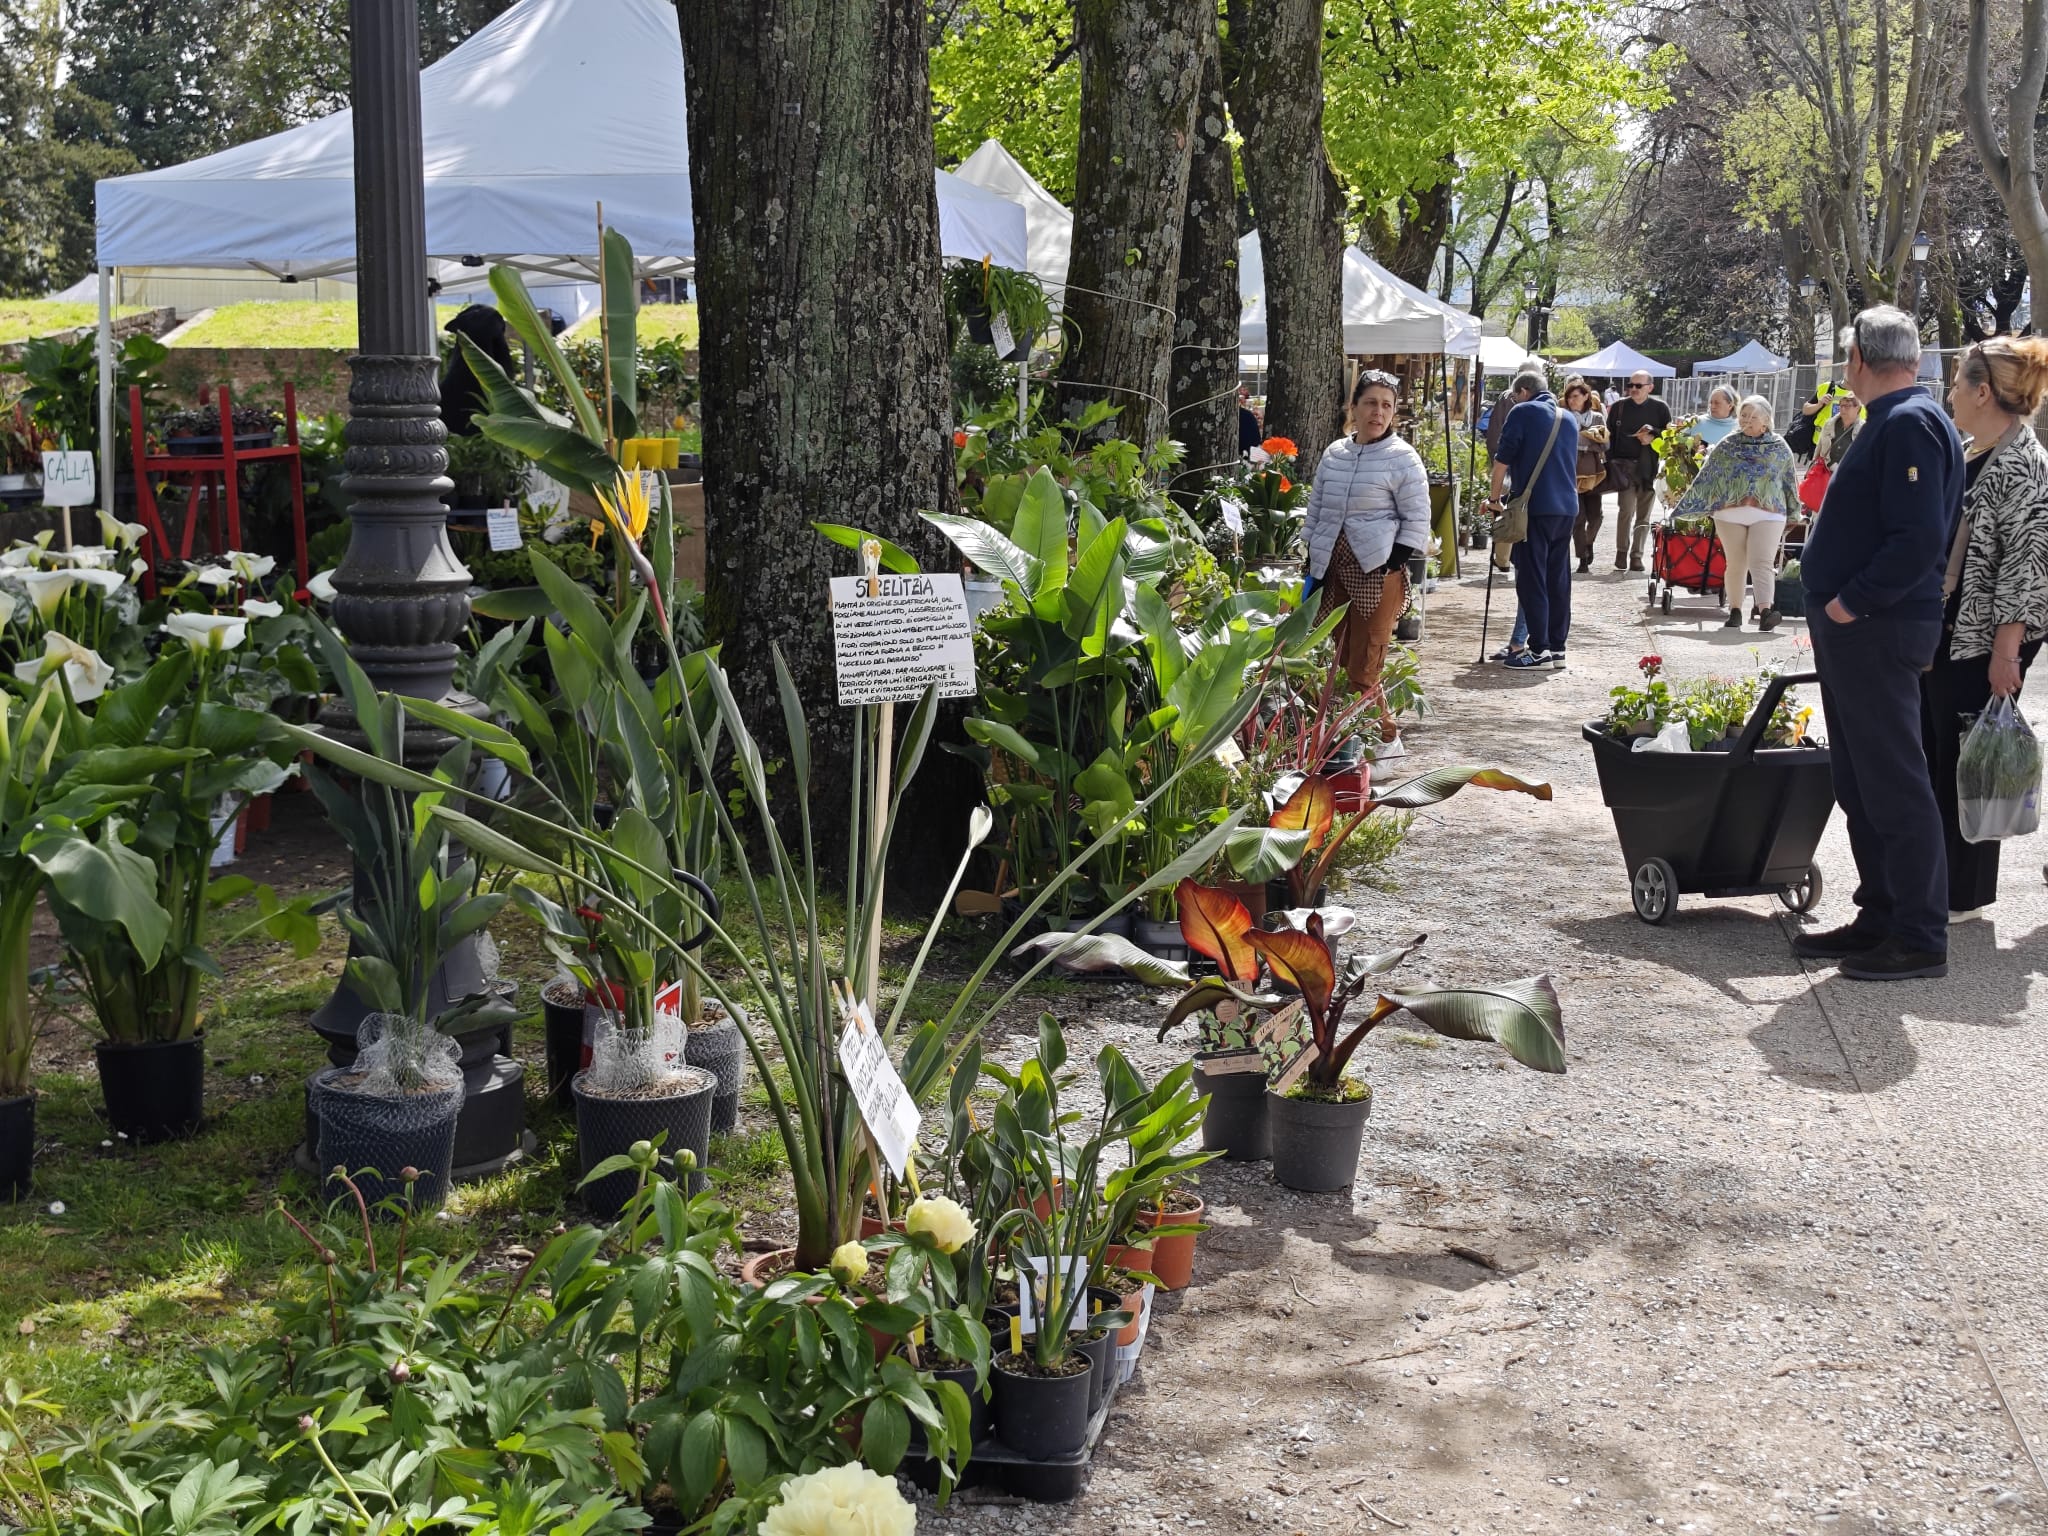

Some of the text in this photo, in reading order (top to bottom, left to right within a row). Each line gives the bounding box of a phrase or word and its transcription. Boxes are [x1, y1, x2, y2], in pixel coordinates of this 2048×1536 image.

[48, 458, 91, 486] CALLA
[914, 614, 945, 622] CONSIGLIA
[837, 630, 881, 640] POSIZIONARLA
[936, 622, 967, 630] LUMINOSO
[839, 678, 872, 687] TERRICCIO
[865, 693, 914, 702] NEBULIZZARE
